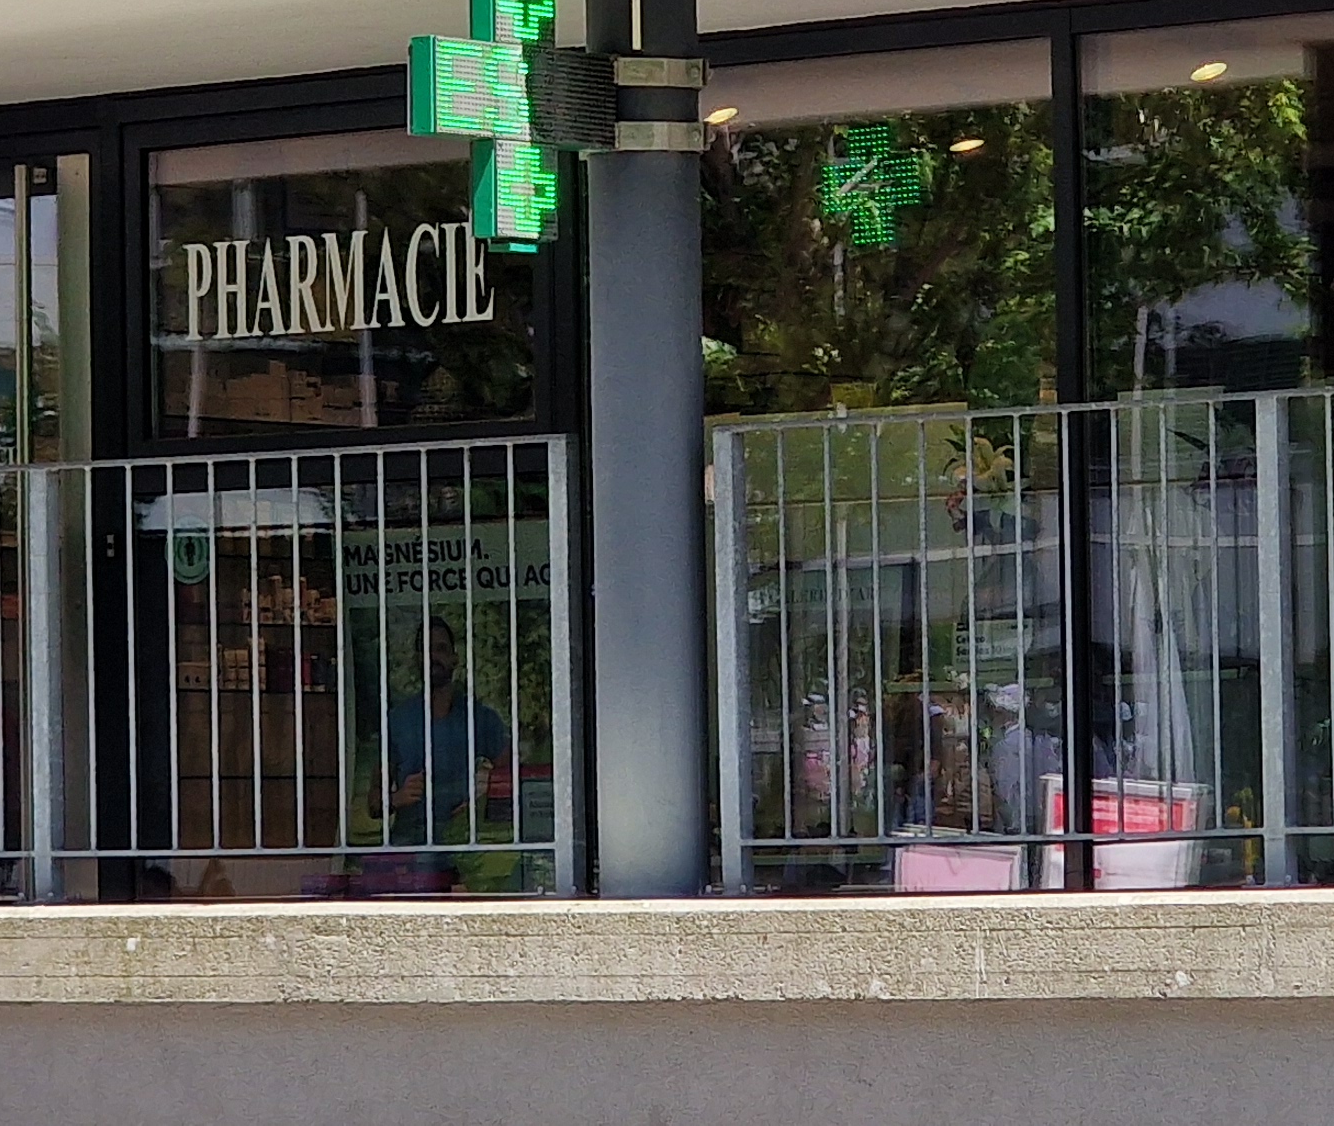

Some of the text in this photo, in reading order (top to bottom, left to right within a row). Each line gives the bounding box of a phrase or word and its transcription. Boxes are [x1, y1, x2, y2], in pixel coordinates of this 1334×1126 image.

[182, 221, 495, 341] PHARMACIE
[343, 535, 490, 567] MAGNÉSIUM.
[398, 568, 467, 593] FORCE
[476, 565, 517, 588] QU
